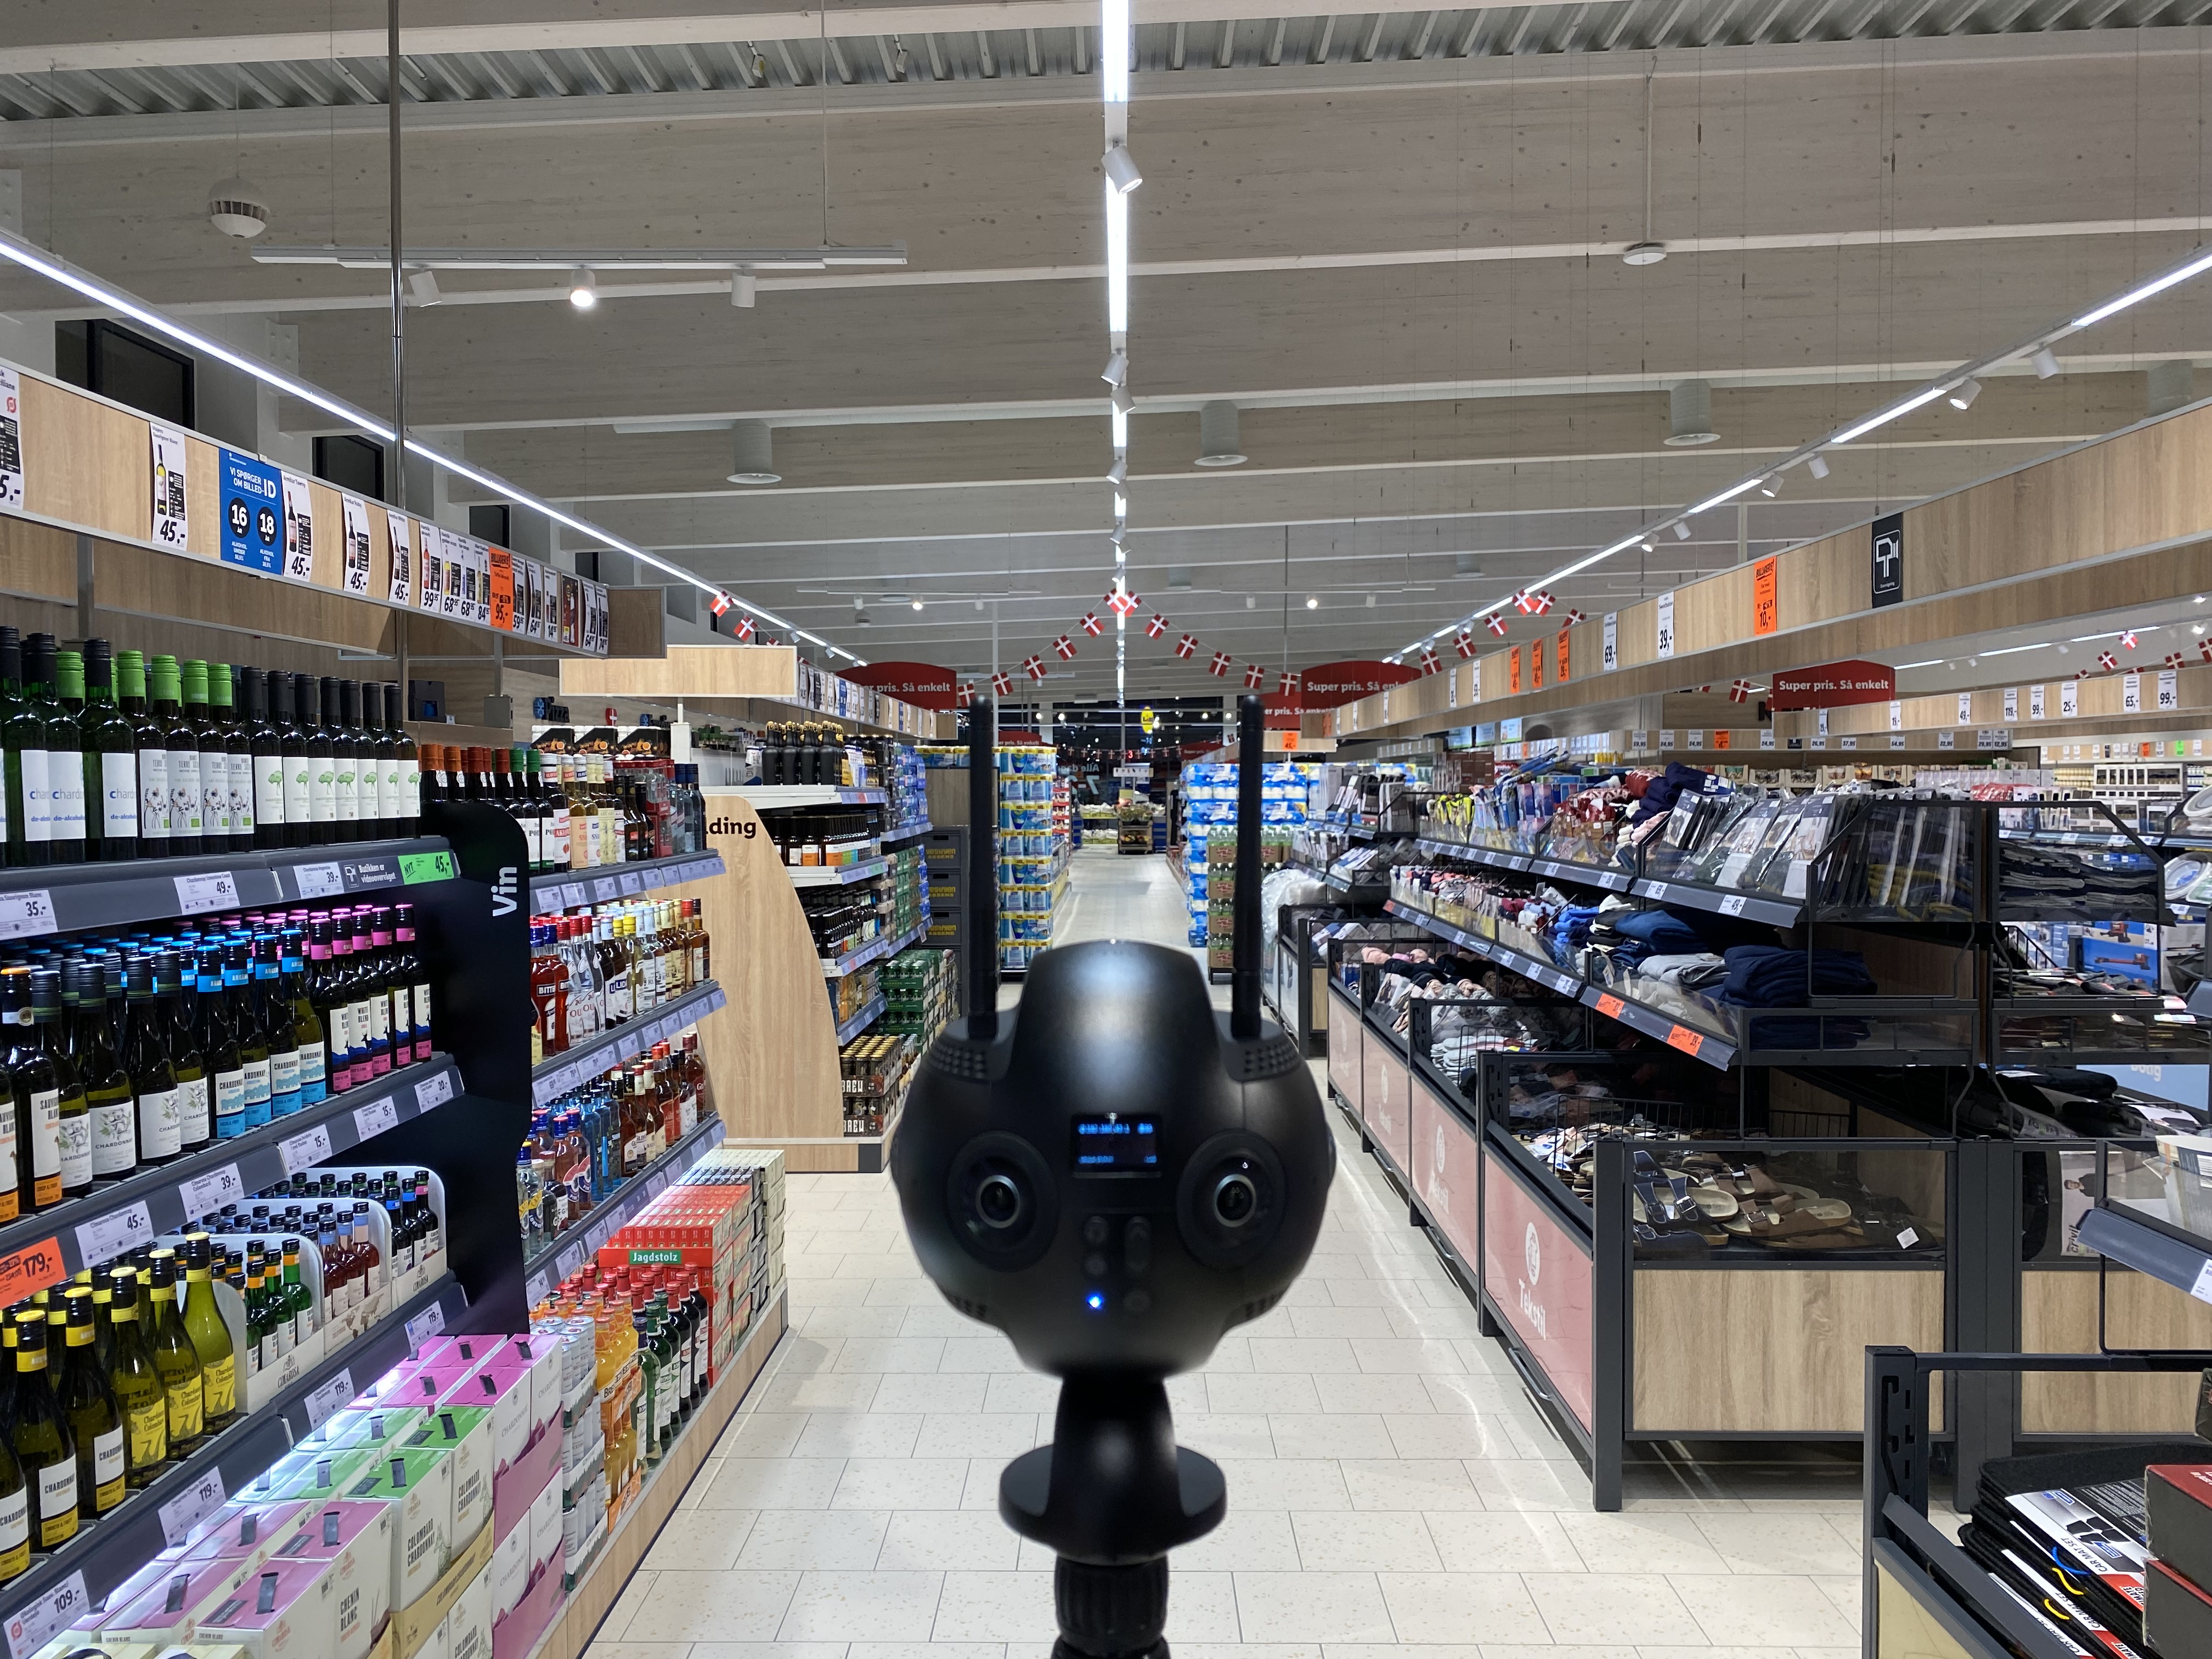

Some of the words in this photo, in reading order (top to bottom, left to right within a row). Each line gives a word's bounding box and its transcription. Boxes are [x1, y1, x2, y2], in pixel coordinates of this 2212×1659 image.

[229, 466, 236, 476] VI
[237, 469, 261, 485] SPØRGER
[233, 478, 243, 487] OM
[264, 479, 276, 499] ID
[232, 504, 247, 527] 16
[260, 514, 274, 535] 18
[1659, 629, 1672, 651] 39,-
[877, 682, 899, 692] pris.
[902, 682, 915, 692] Så
[917, 682, 951, 692] enkelt
[1307, 681, 1339, 693] Super
[1341, 682, 1364, 693] pris.
[1367, 680, 1379, 690] Så
[1779, 680, 1810, 692] Super
[1814, 680, 1837, 691] pris.
[1840, 679, 1853, 690] Så
[1855, 680, 1889, 690] enkelt
[706, 816, 756, 839] ding
[404, 862, 414, 876] NYT
[435, 855, 450, 874] 45,-
[491, 867, 517, 917] Vin
[22, 1252, 53, 1277] 179,-
[633, 1252, 678, 1263] Jagdstolz
[1519, 1278, 1546, 1341] Tekstil
[408, 1518, 433, 1552] COLOMBARD
[2061, 1537, 2079, 1548] SET
[2074, 1548, 2091, 1561] MAT
[2089, 1558, 2108, 1572] CAR
[54, 1589, 80, 1614] 109.-
[341, 1588, 359, 1615] CHENIN
[2055, 1592, 2074, 1606] SET
[340, 1606, 357, 1632] BLANC
[2068, 1604, 2086, 1620] MAT
[2083, 1616, 2101, 1629] CAR
